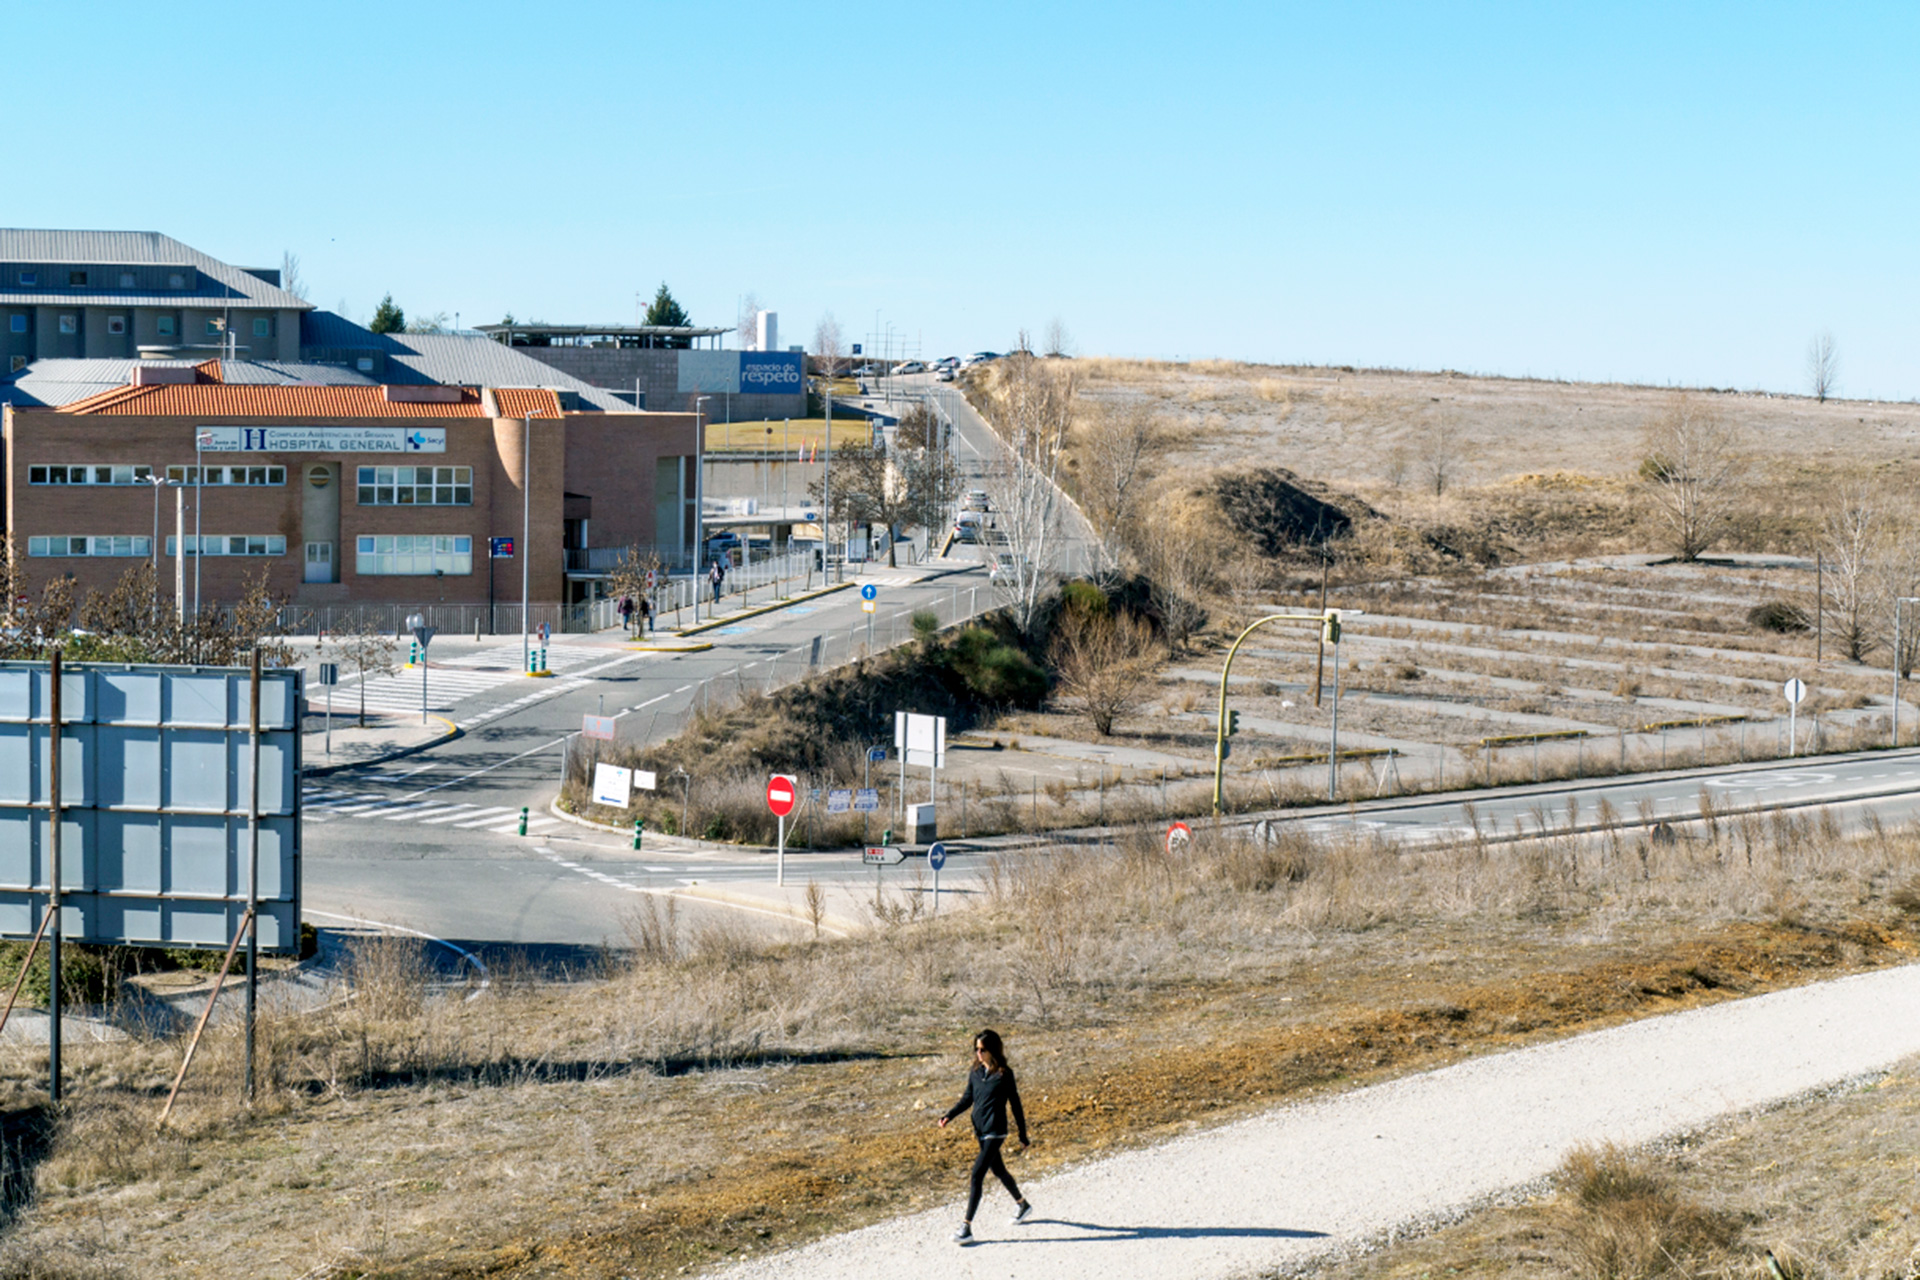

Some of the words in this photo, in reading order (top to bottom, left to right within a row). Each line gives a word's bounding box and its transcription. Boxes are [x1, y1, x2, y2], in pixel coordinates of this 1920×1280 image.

[746, 363, 781, 373] espacio
[783, 363, 796, 372] de
[742, 371, 799, 386] respeto
[244, 428, 267, 450] H
[269, 439, 334, 450] HOSPITAL
[339, 440, 400, 450] GENERAL
